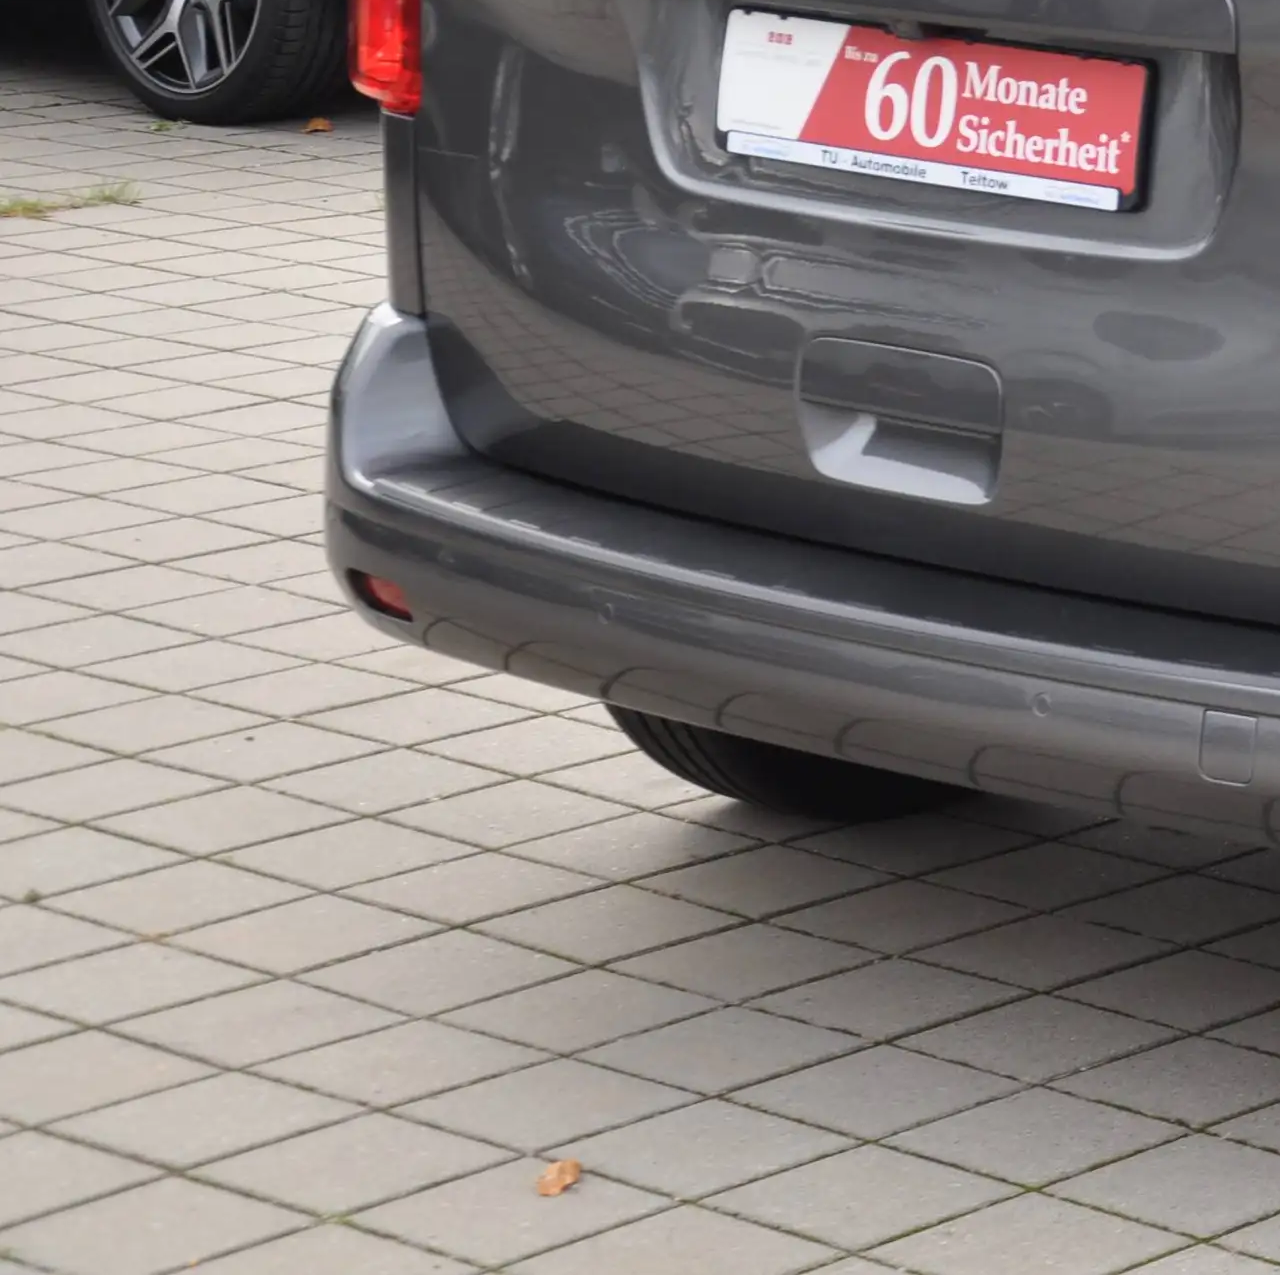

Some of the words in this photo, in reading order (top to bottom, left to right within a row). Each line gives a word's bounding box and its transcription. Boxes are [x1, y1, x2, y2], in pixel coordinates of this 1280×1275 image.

[864, 50, 958, 148] 60
[961, 61, 1088, 115] Monate
[850, 155, 927, 179] Automobile
[960, 171, 1008, 190] Teltow
